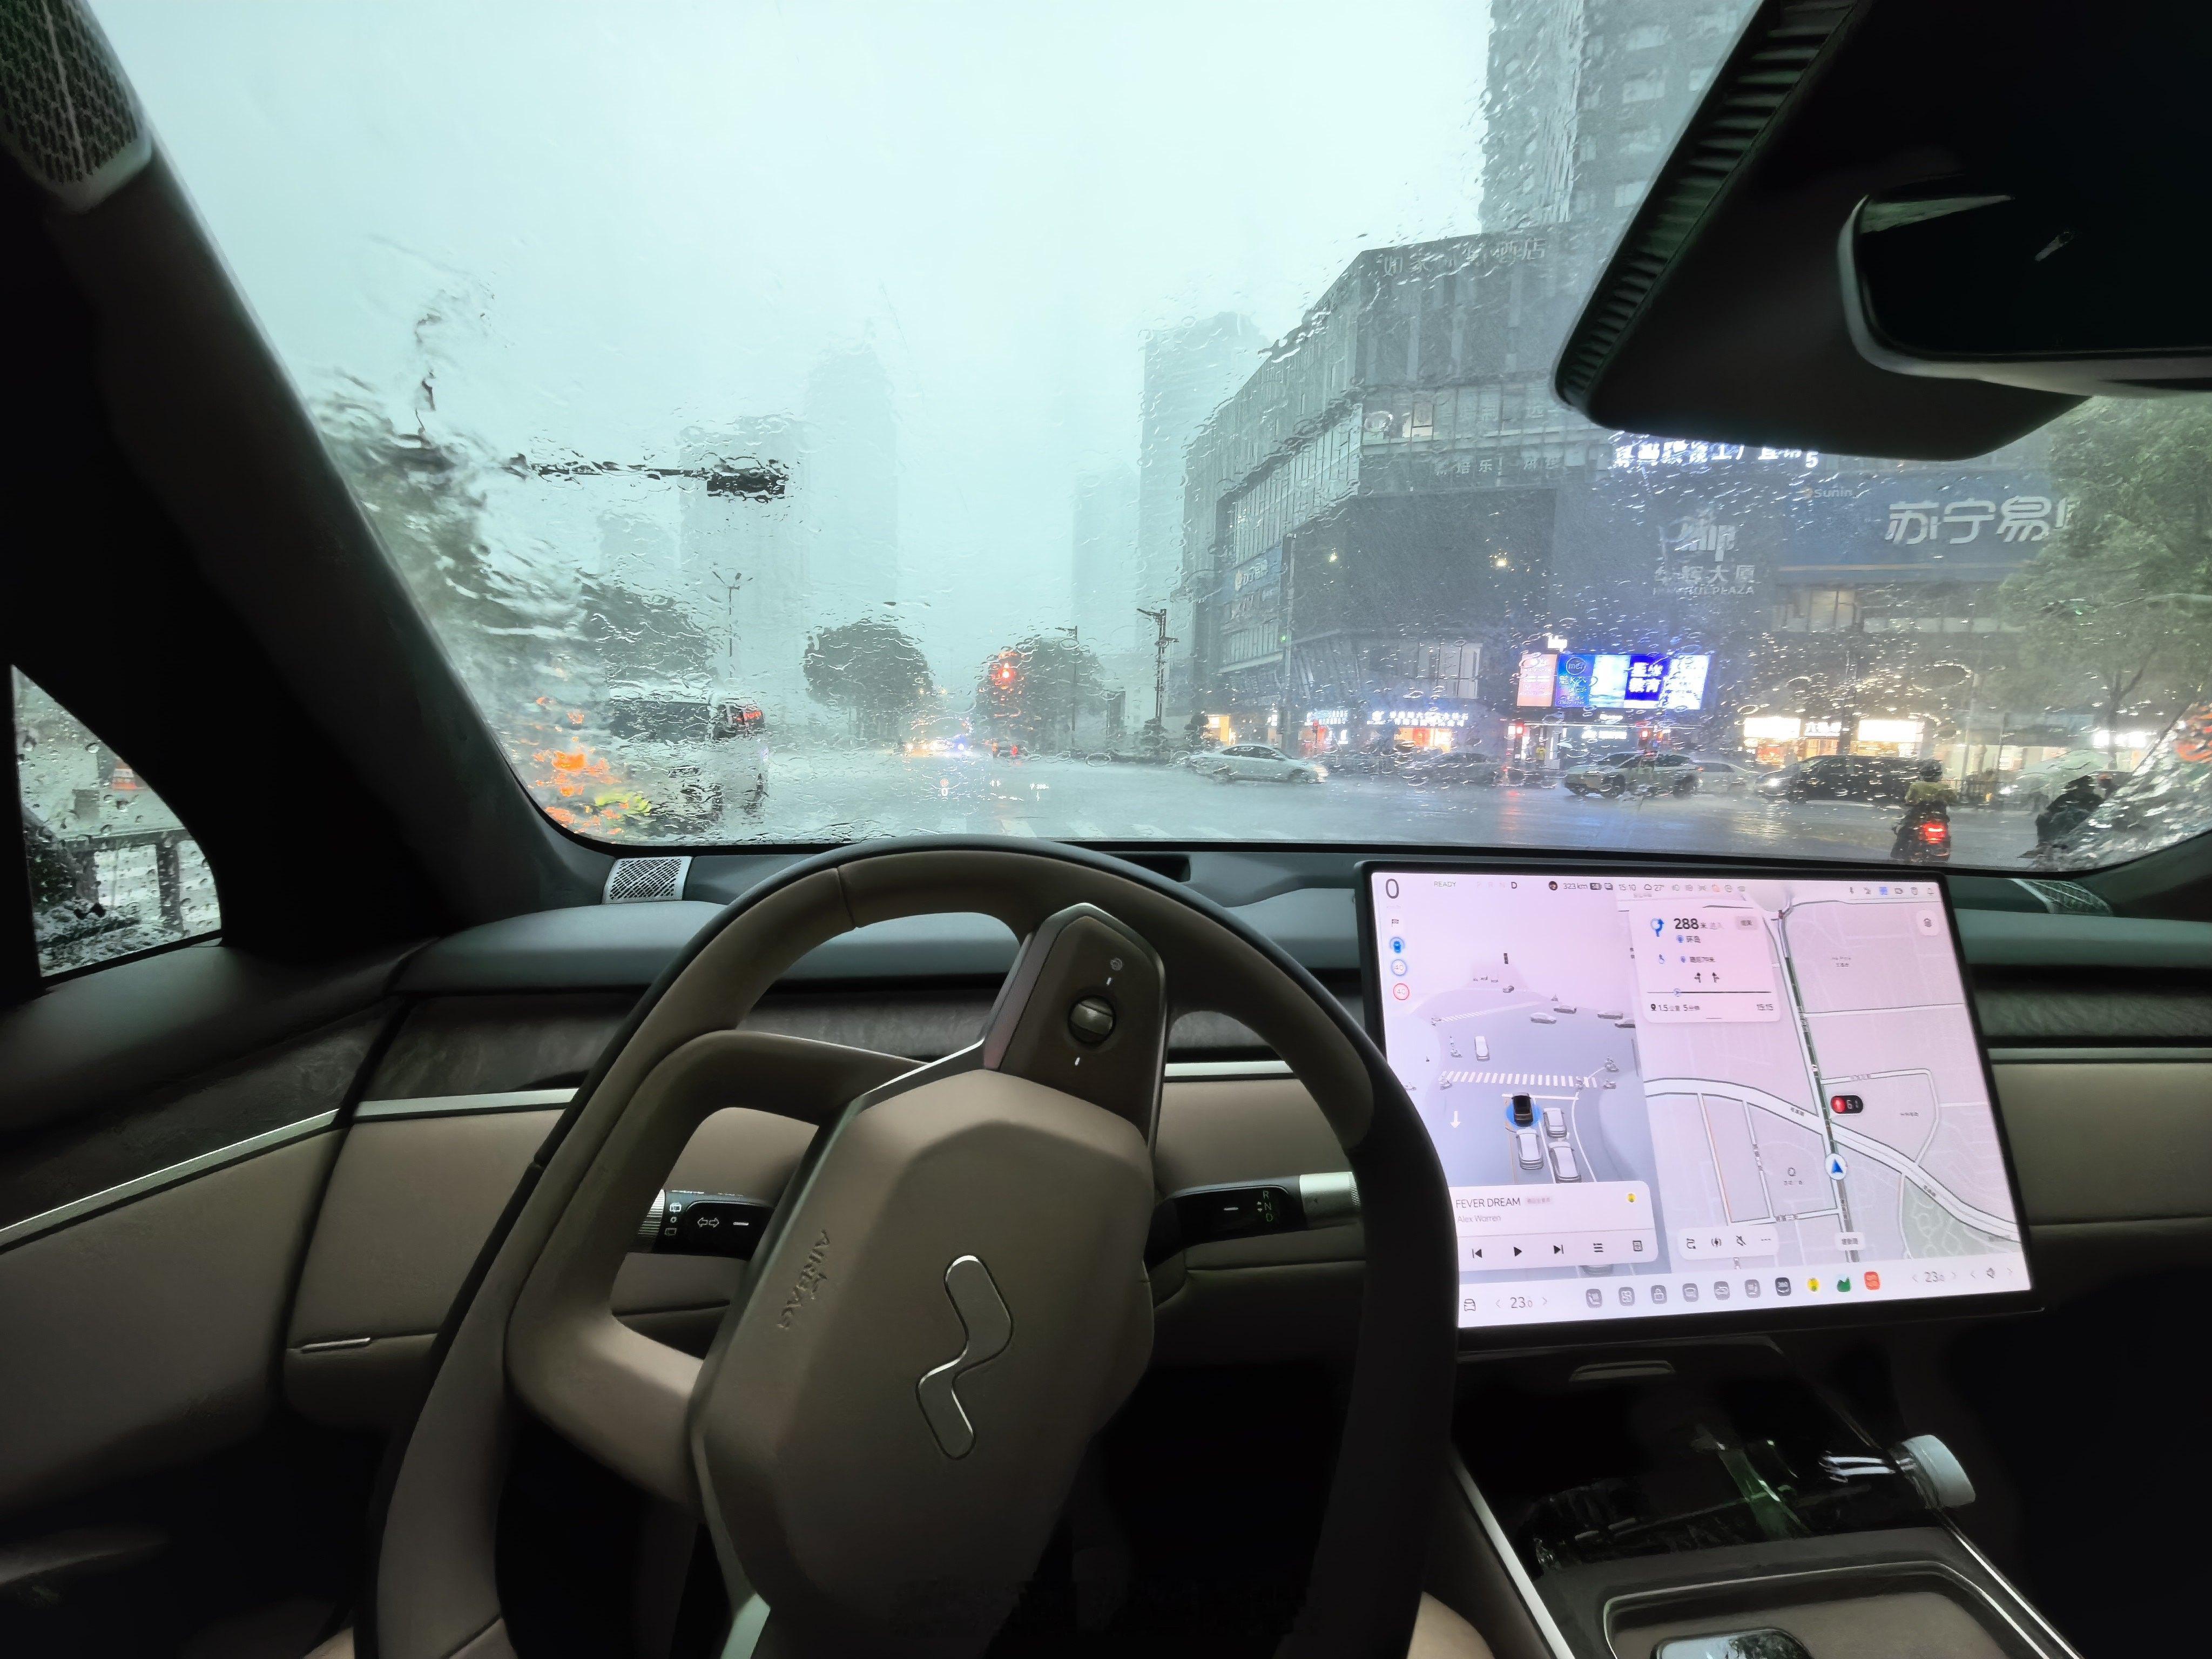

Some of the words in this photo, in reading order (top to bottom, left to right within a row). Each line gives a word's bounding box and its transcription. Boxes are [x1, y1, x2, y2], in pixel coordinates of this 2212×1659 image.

[1885, 495, 2073, 544] 苏宁易
[1386, 878, 1400, 899] 0
[1263, 1190, 1270, 1199] R
[1264, 1202, 1272, 1211] N
[1456, 1199, 1485, 1208] FEVER
[1487, 1197, 1521, 1207] DREAM
